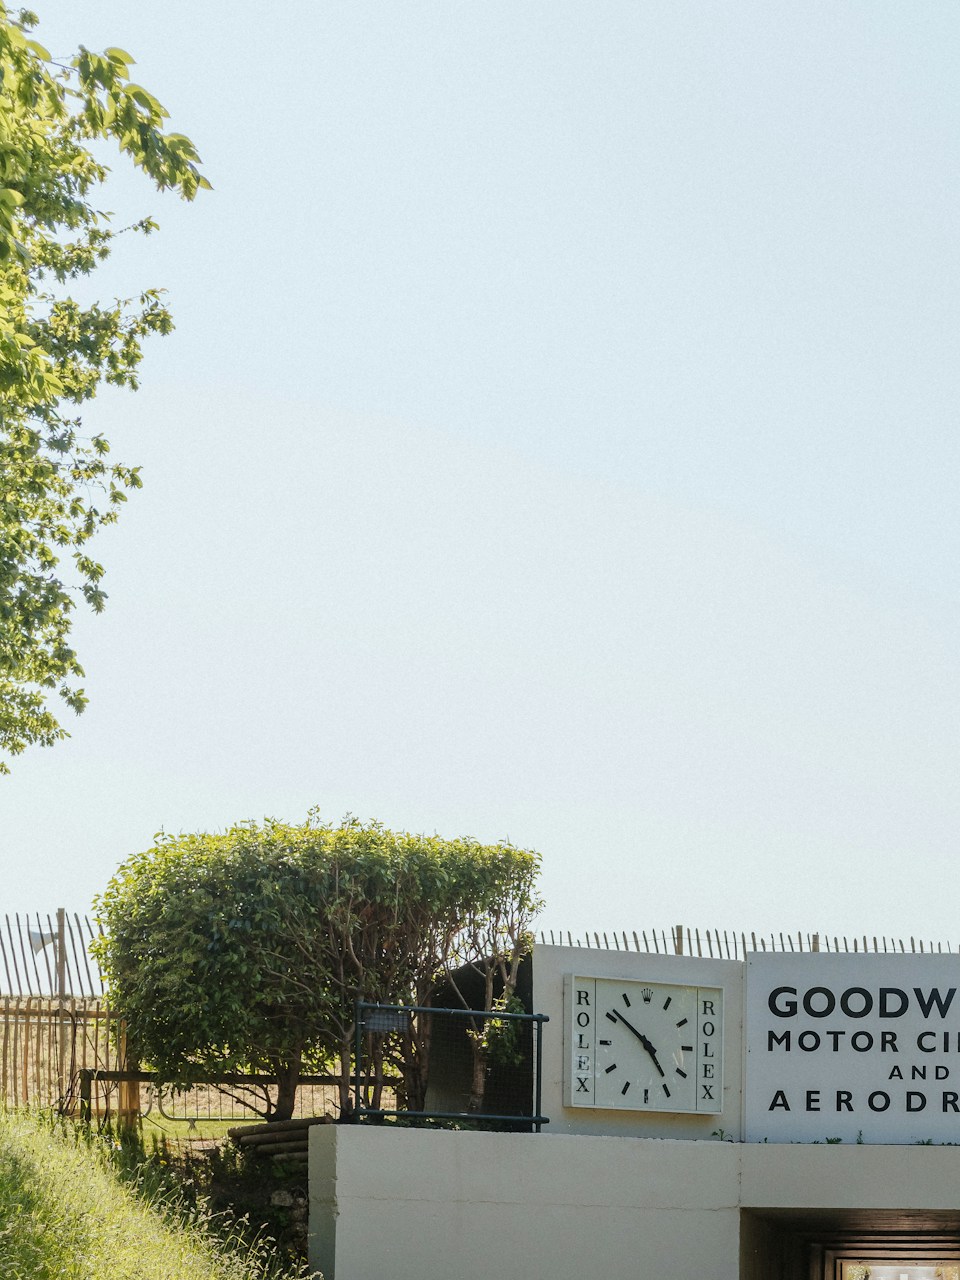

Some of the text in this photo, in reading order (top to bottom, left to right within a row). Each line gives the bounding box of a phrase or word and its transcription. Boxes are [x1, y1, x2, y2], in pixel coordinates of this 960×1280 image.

[576, 990, 591, 1093] ROLEX
[702, 1000, 716, 1100] ROLEX
[767, 1030, 899, 1053] MOTOR
[888, 1065, 950, 1081] AND
